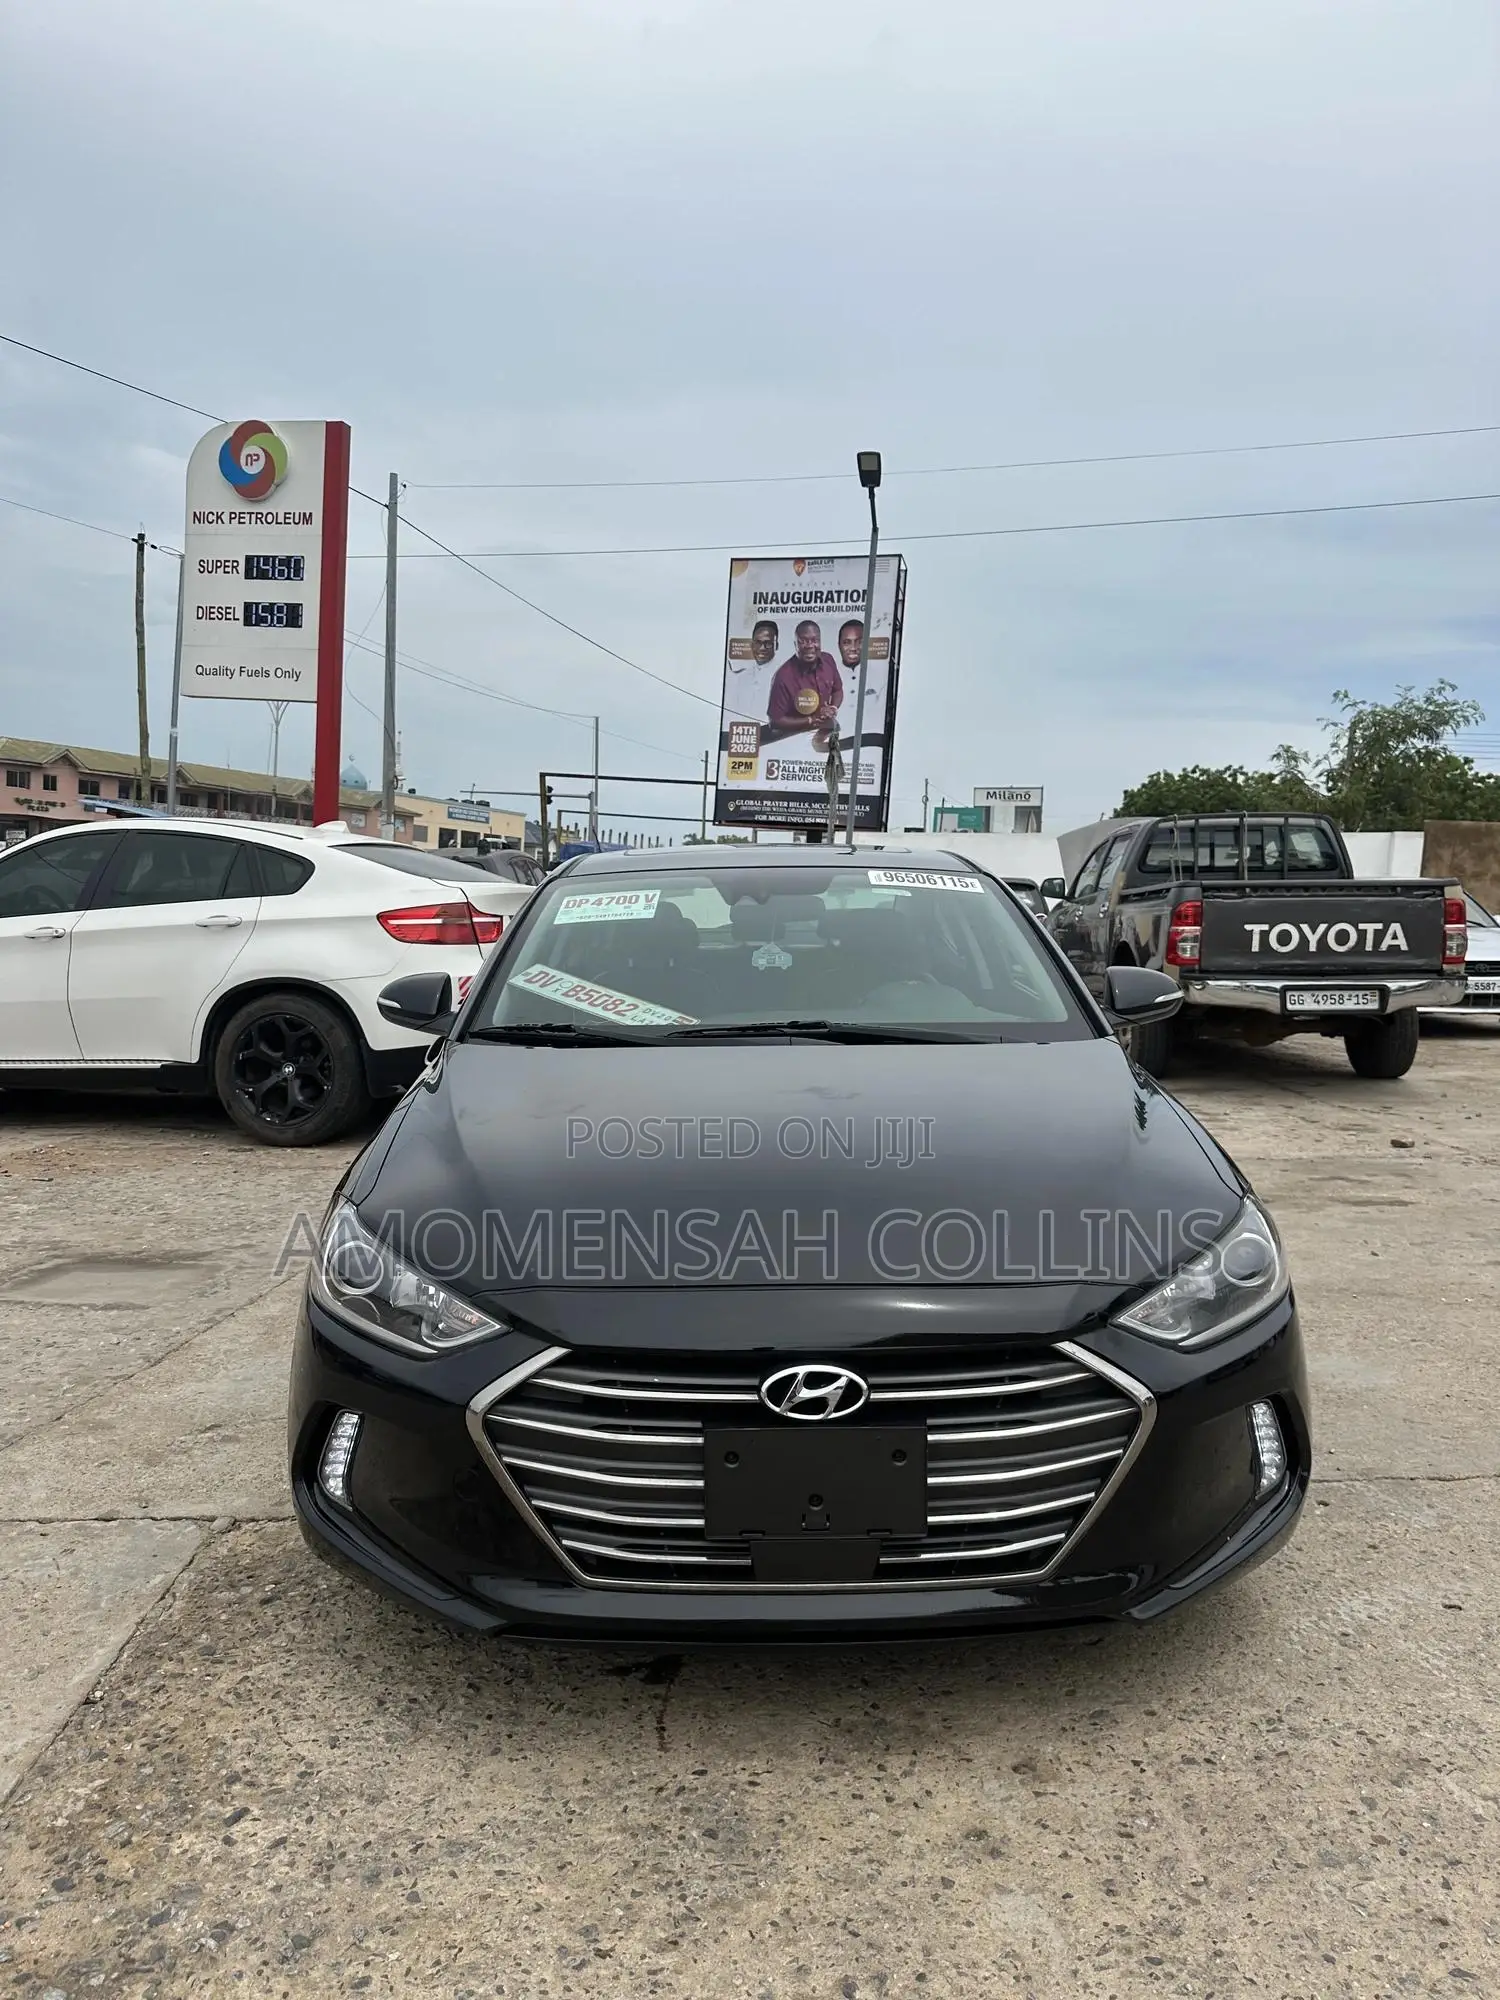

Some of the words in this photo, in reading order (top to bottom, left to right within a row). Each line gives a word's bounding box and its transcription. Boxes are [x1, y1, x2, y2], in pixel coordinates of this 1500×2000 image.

[192, 511, 225, 525] NICK
[229, 511, 313, 525] PETROLEUM
[198, 559, 240, 574] SUPER
[253, 556, 304, 580] 14.60
[196, 605, 240, 621] DIESEL
[791, 605, 824, 613] CHURCH
[826, 604, 866, 612] BUILDING
[195, 664, 236, 680] Quality
[239, 666, 271, 678] Fuels
[274, 667, 302, 682] Only
[732, 726, 756, 735] 14TH
[731, 735, 756, 744] JUNE
[730, 744, 756, 753] 2026
[731, 761, 753, 770] 2PM
[767, 760, 779, 779] 3
[780, 773, 823, 782] SERVICES
[986, 790, 1032, 802] Milano
[564, 899, 590, 909] DP
[591, 895, 640, 907] 4700
[644, 893, 657, 904] V
[1244, 923, 1409, 953] TOYOTA
[524, 970, 563, 988] DV
[562, 984, 641, 1017] B5082
[1289, 994, 1305, 1005] GG
